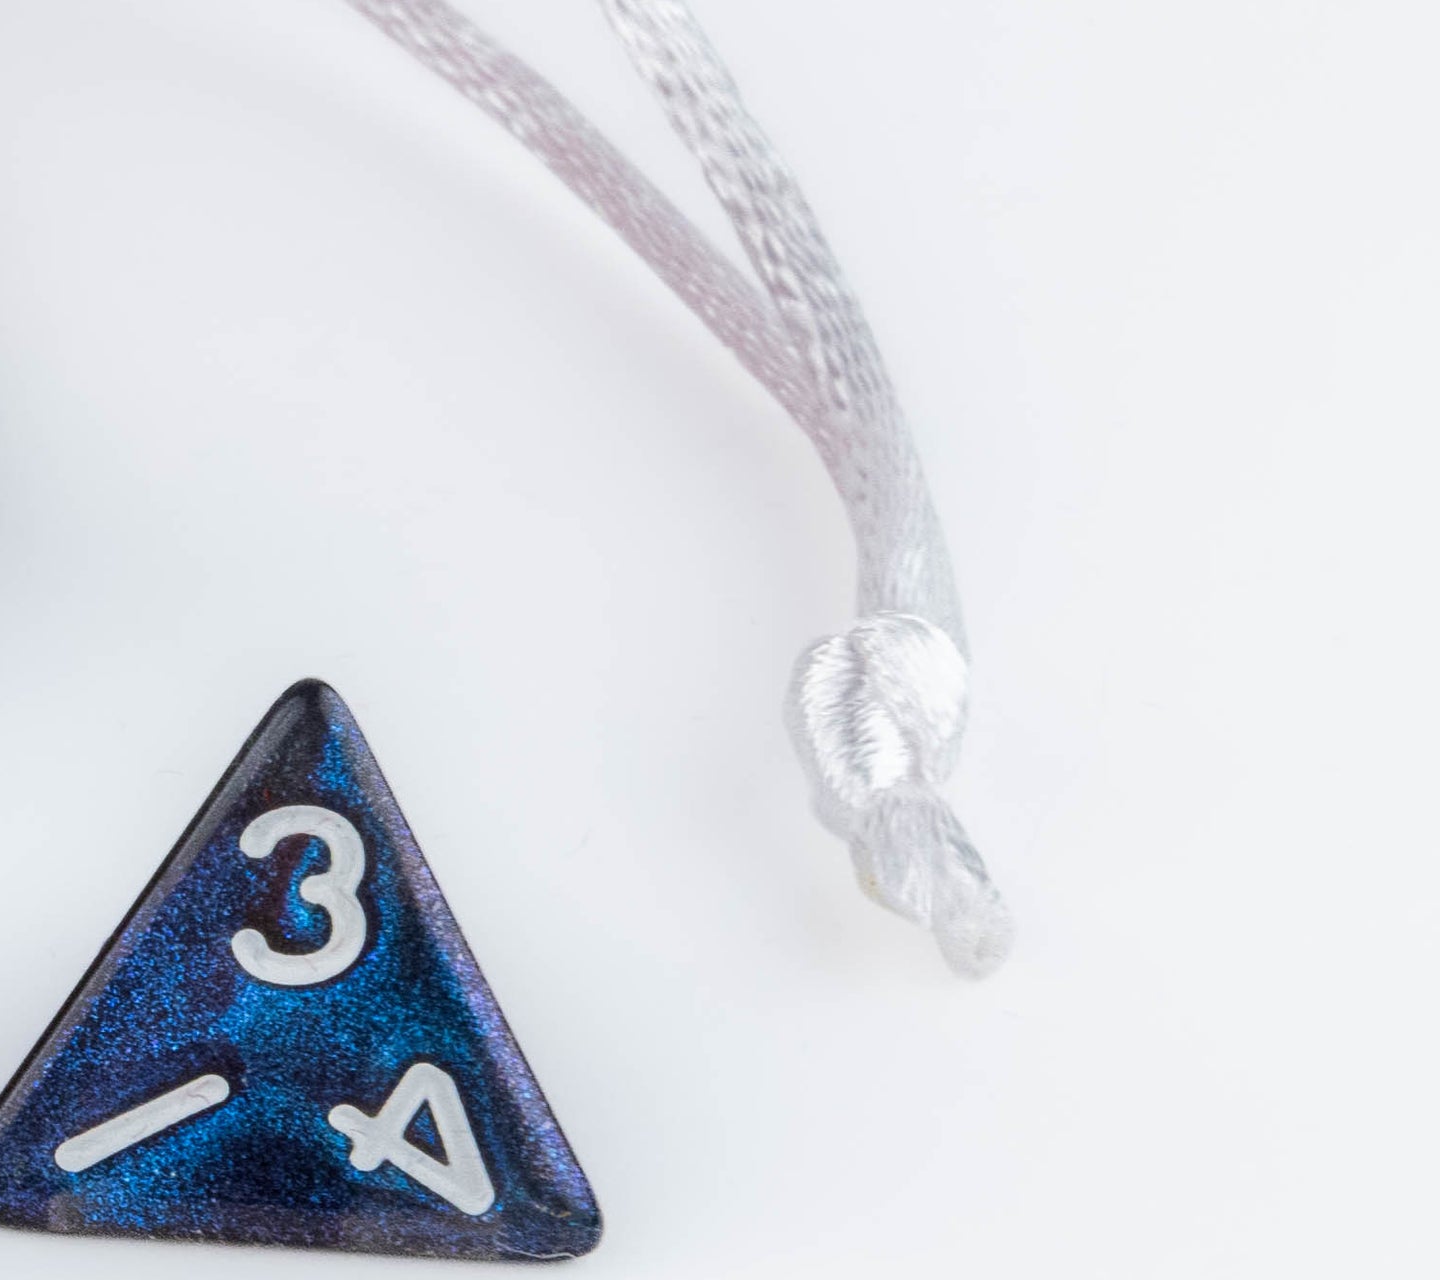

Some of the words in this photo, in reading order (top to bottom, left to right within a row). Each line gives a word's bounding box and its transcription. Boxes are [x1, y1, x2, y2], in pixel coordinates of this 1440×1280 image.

[229, 803, 367, 987] 3
[53, 1073, 231, 1174] 1
[327, 1061, 496, 1217] 4
